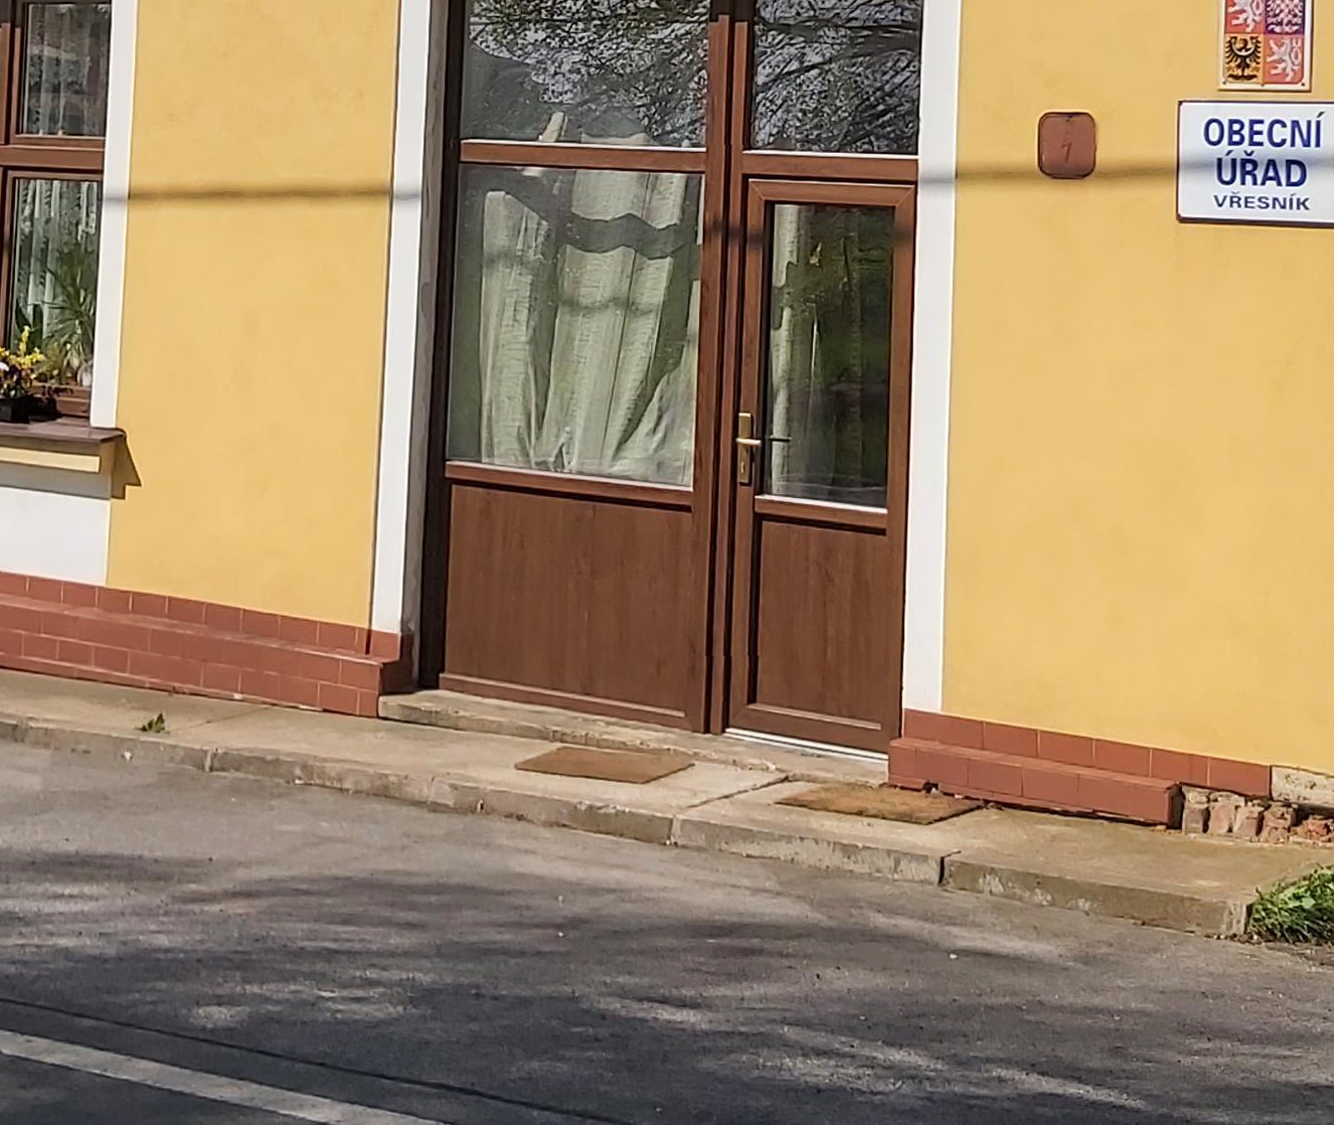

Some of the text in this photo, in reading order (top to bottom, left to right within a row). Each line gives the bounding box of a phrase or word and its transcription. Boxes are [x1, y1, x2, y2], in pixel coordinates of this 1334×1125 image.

[1203, 111, 1326, 149] OBECNÍ
[1216, 149, 1308, 188] ÚŘAD
[1213, 190, 1311, 211] VŘESNÍK
